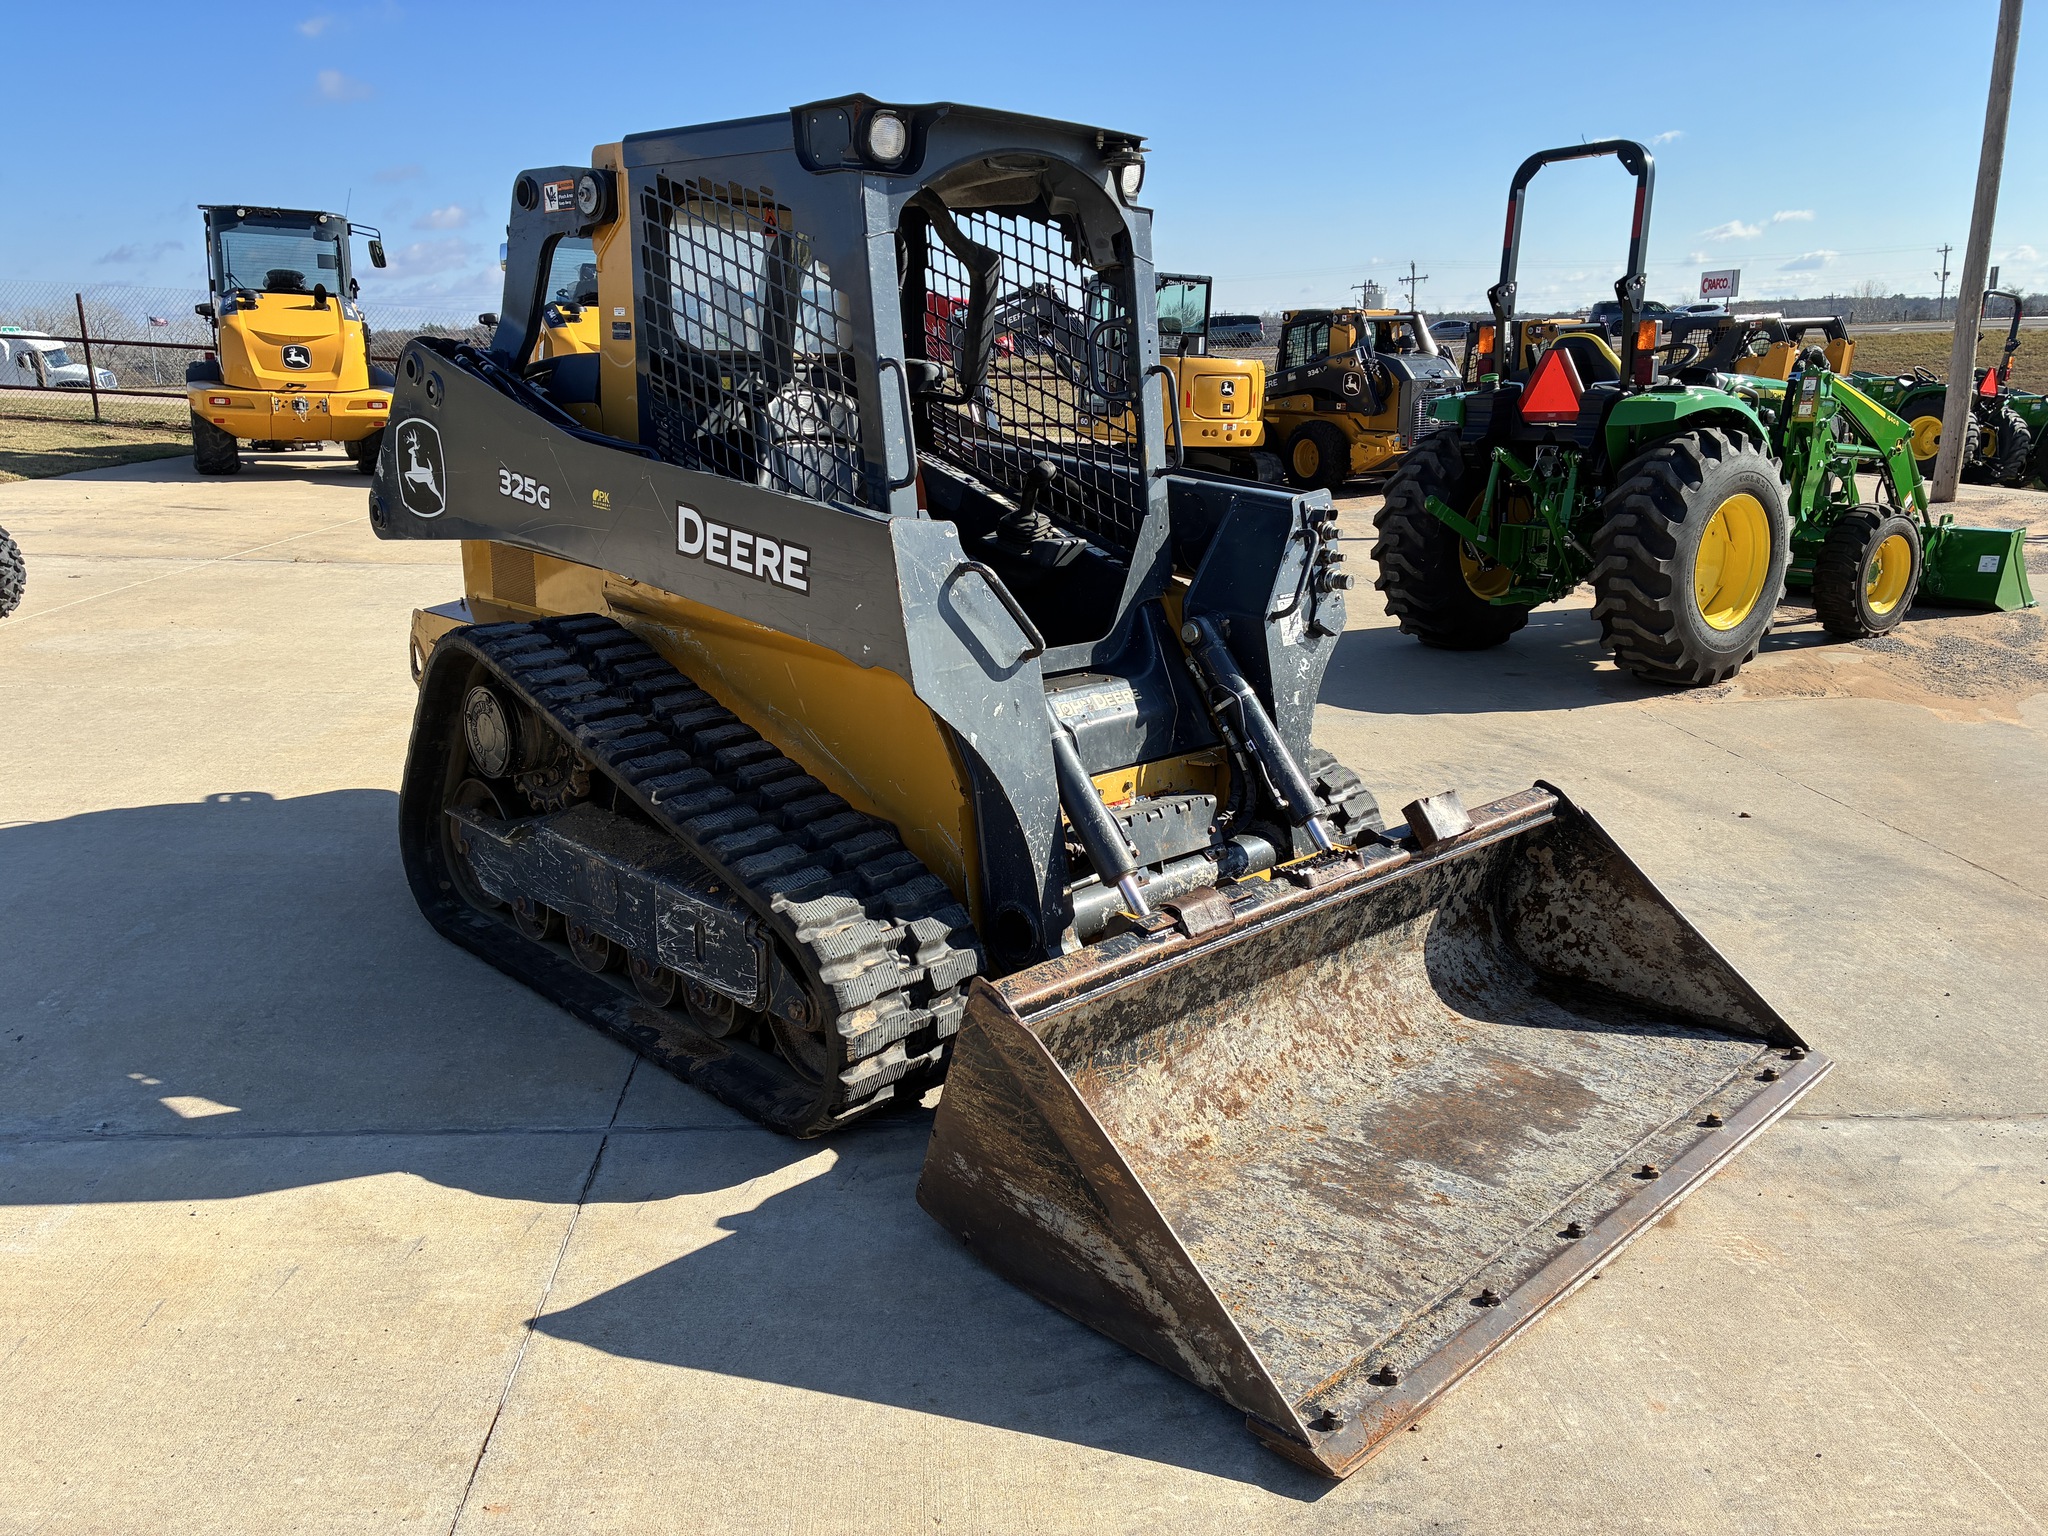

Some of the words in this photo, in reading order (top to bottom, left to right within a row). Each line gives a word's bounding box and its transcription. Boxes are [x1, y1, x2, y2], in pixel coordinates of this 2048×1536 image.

[1702, 277, 1728, 293] CRAFCO
[499, 469, 550, 510] 325G
[678, 505, 808, 591] DEERE
[1090, 688, 1143, 710] DEERE
